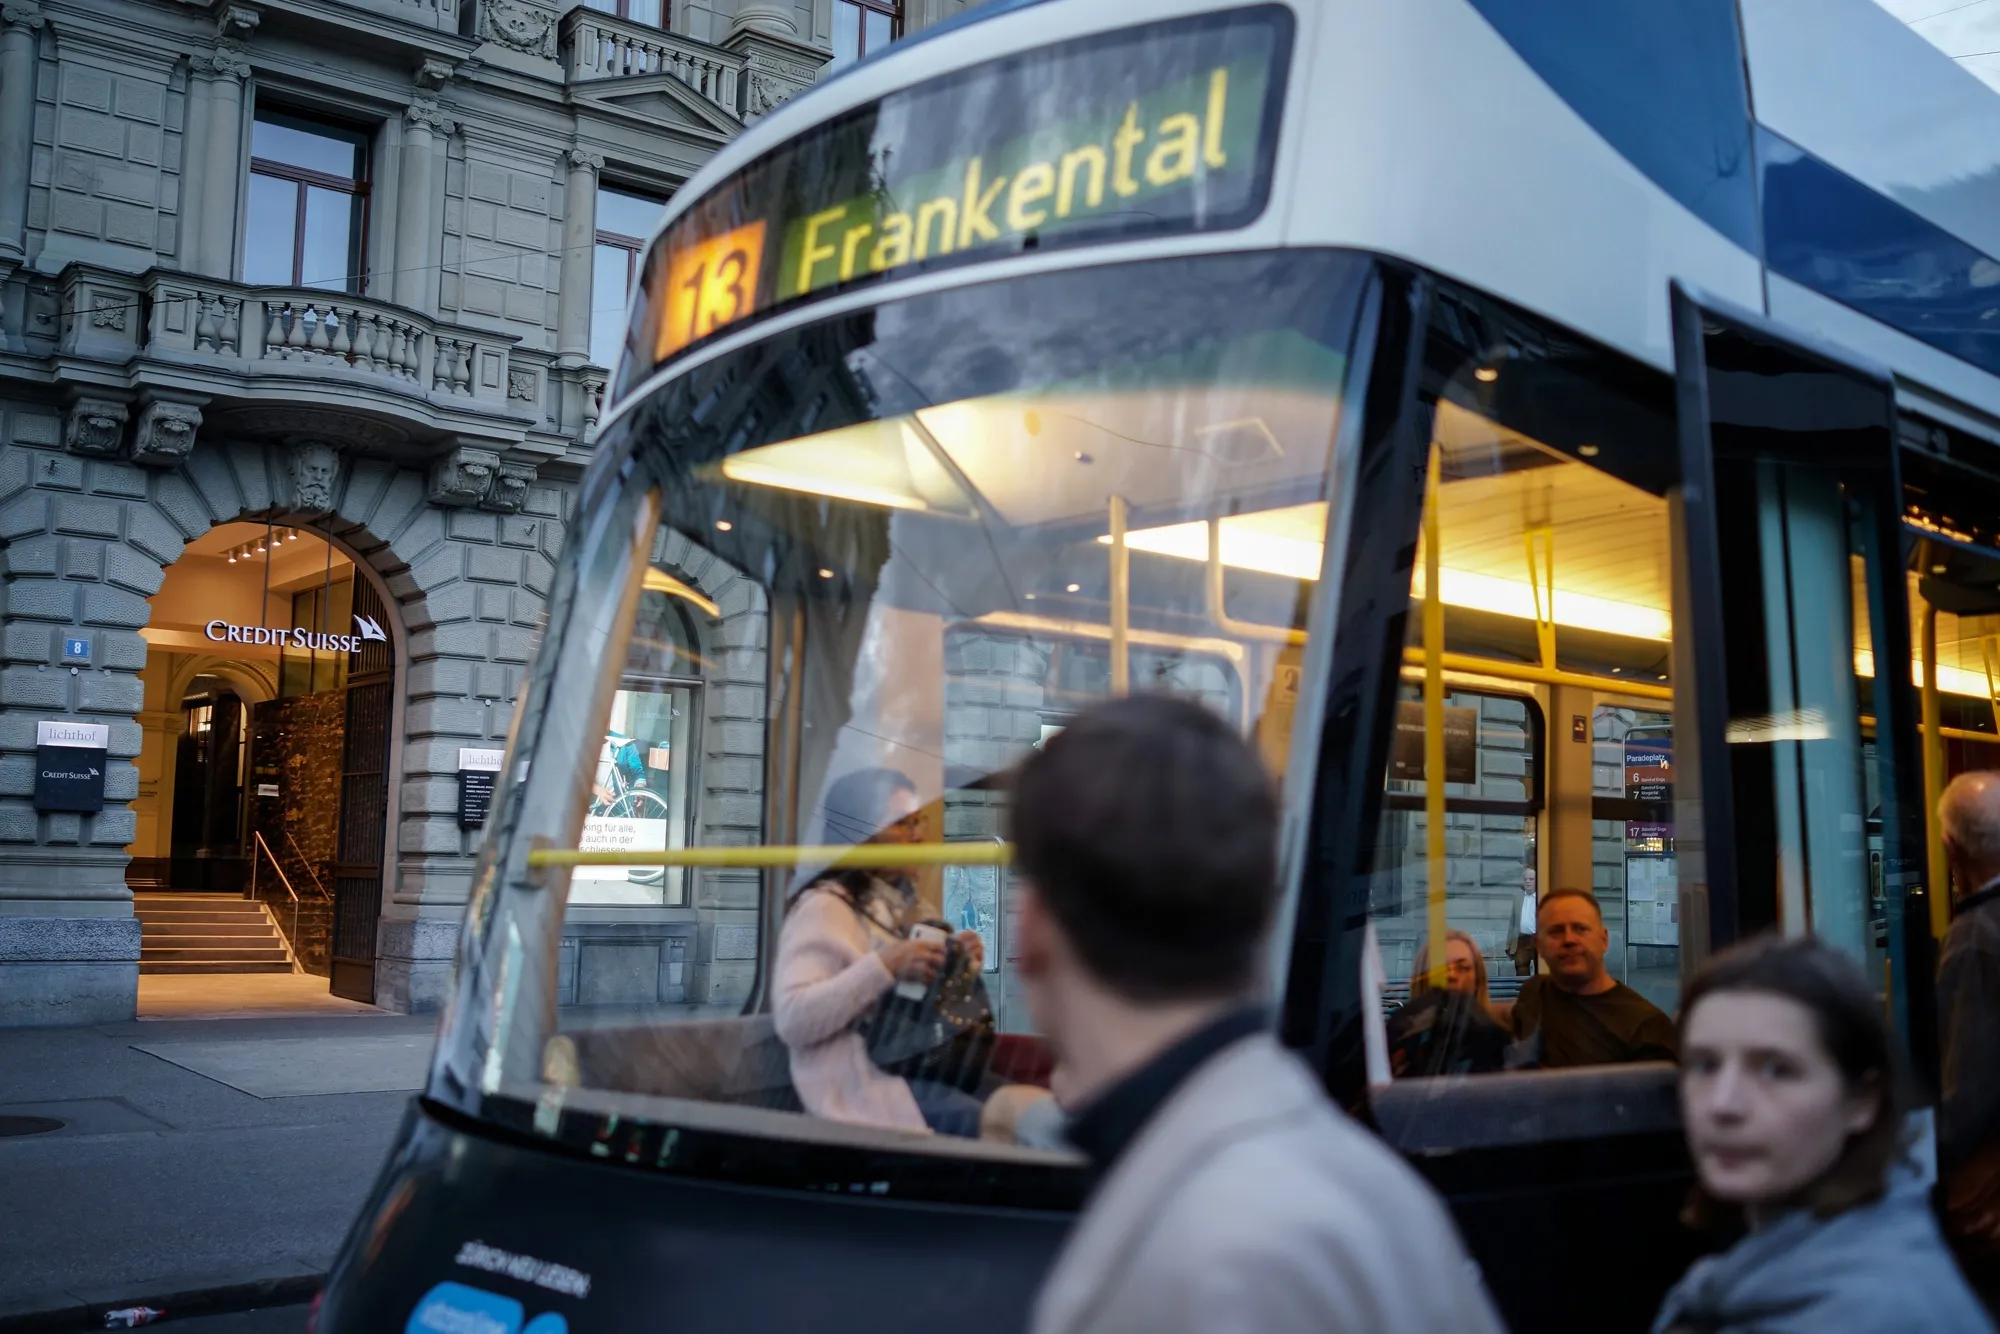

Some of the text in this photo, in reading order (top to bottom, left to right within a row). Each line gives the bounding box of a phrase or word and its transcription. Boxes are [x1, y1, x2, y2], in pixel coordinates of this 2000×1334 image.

[680, 65, 1230, 338] 13 Frankental
[206, 619, 362, 653] CREDIT SUISSE
[74, 642, 82, 654] 8
[49, 728, 97, 742] lichthof
[468, 754, 503, 766] lichtho
[1626, 754, 1665, 763] Paradeplatz
[42, 770, 92, 780] CREDIT SUISSE
[1633, 773, 1640, 783] 6
[1633, 791, 1639, 800] 7
[584, 823, 636, 834] king für alle,
[1629, 827, 1640, 837] 17
[585, 835, 607, 843] auch
[619, 836, 634, 844] der
